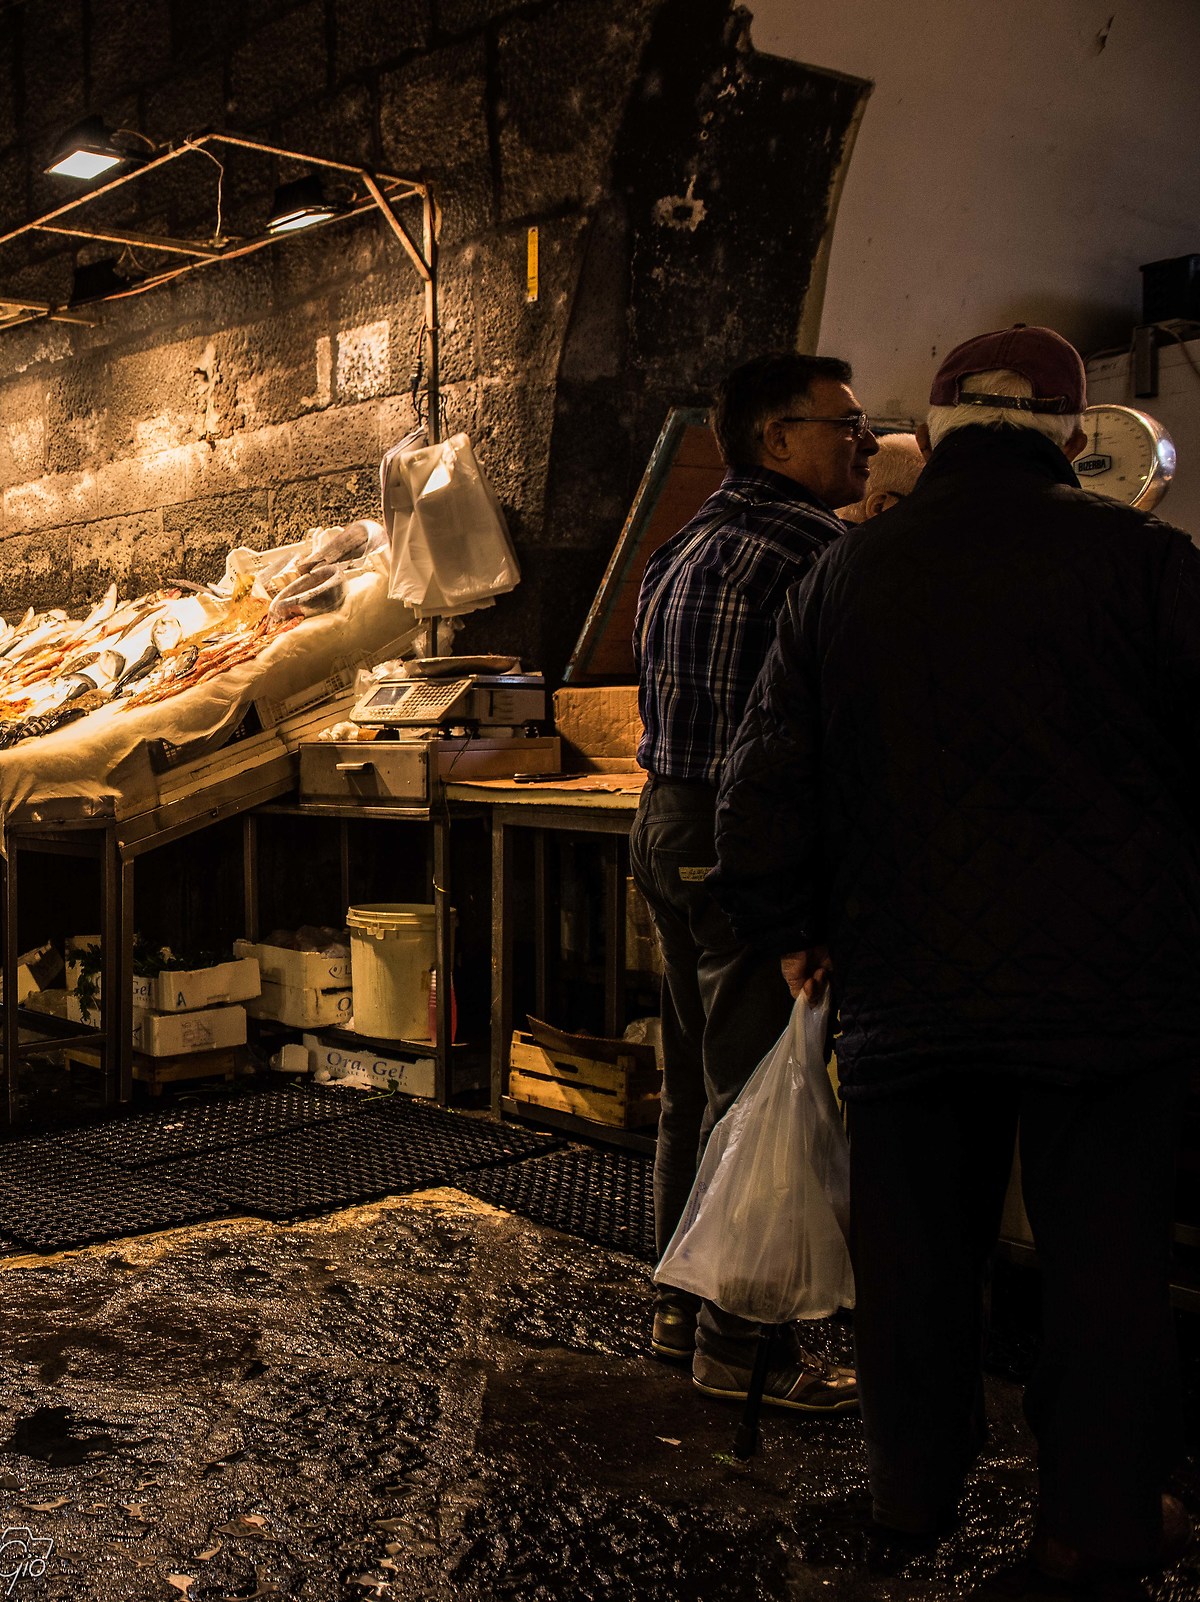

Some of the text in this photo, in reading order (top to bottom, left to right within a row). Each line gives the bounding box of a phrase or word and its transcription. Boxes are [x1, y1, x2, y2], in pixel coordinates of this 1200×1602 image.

[1078, 459, 1106, 472] BIZERBA
[177, 991, 187, 1007] A
[337, 996, 352, 1012] O
